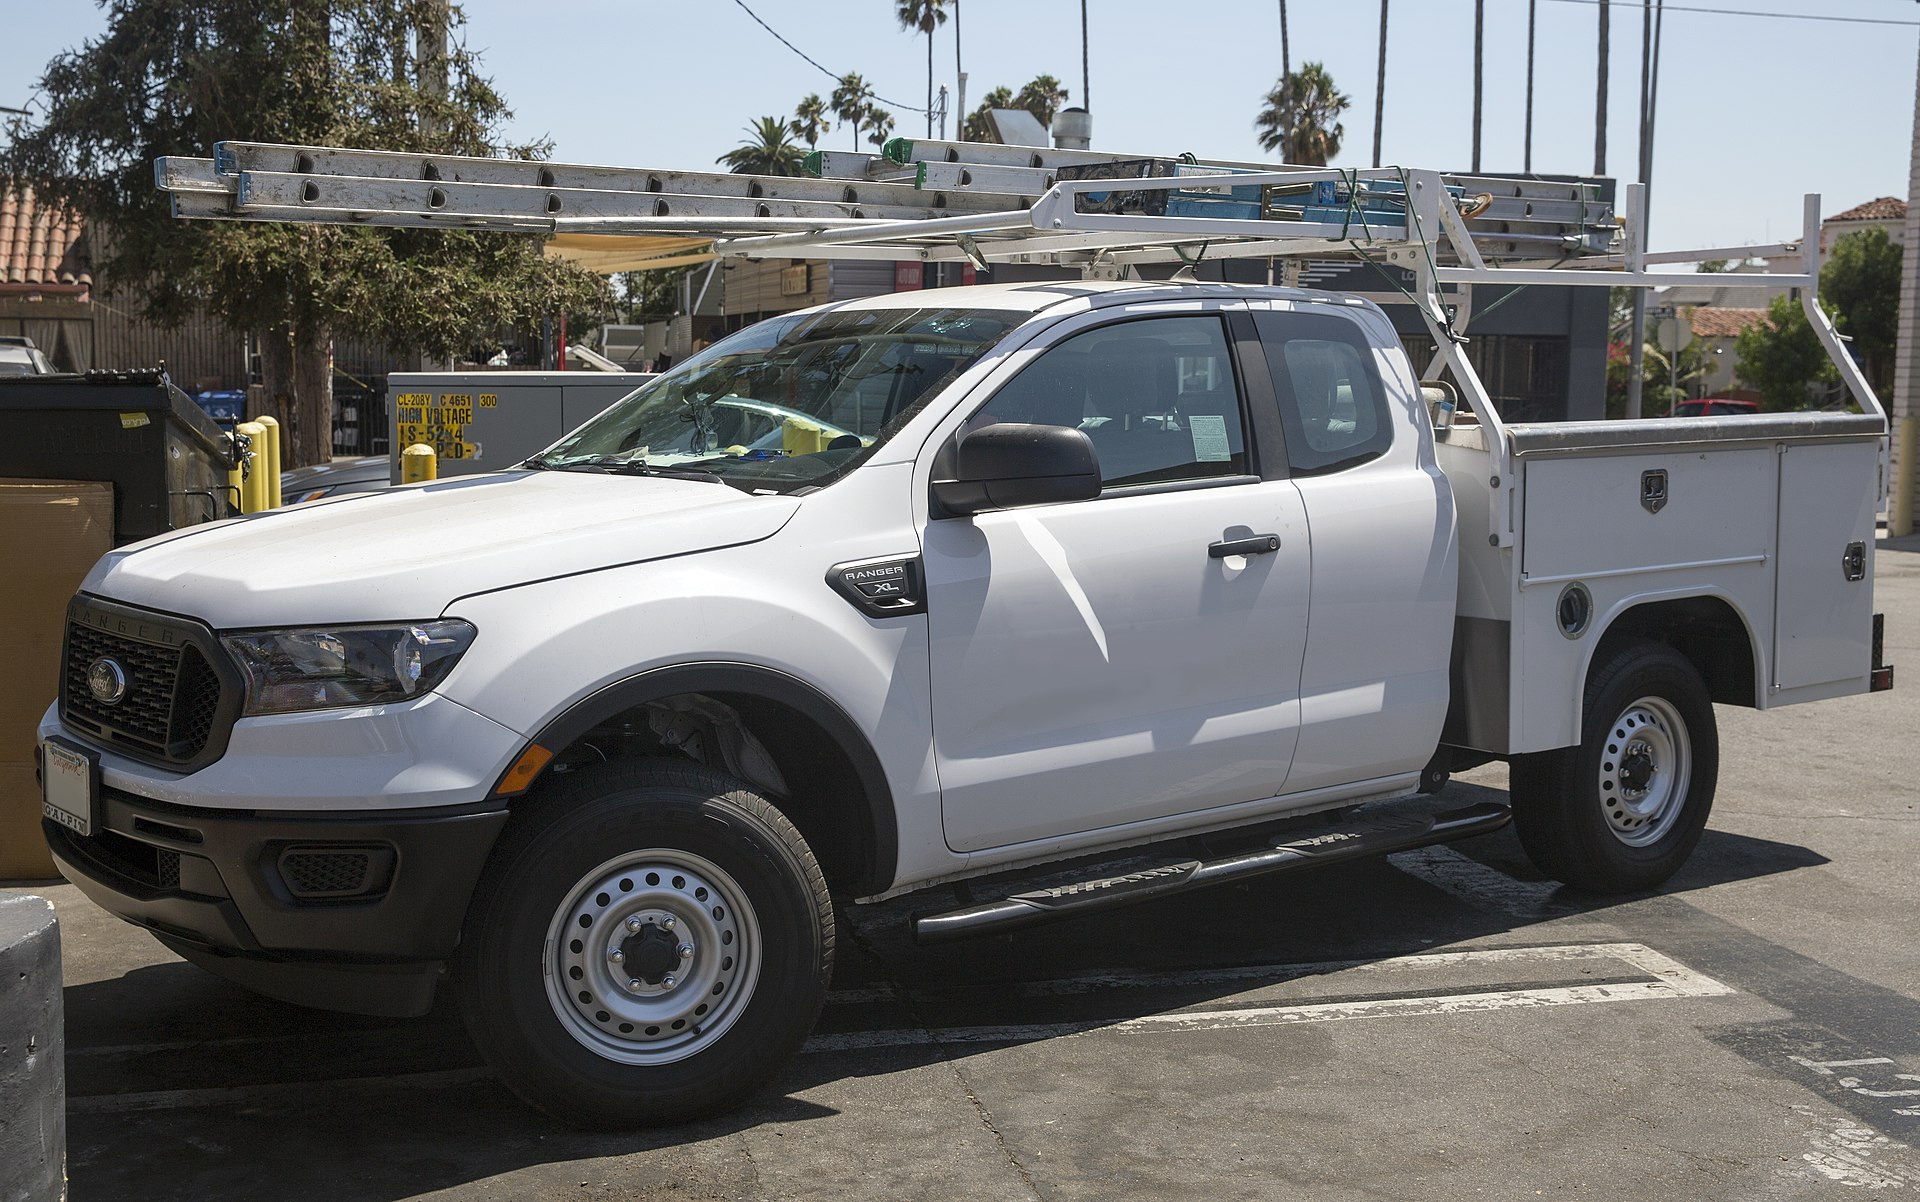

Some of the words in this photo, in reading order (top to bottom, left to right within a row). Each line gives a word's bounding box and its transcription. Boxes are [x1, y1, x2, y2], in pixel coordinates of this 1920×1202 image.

[398, 394, 430, 406] CL-208Y
[440, 395, 447, 406] C
[449, 395, 471, 406] 4651
[480, 395, 497, 407] 300
[398, 407, 423, 424] HIGH
[426, 408, 472, 425] VOLTAGE
[845, 566, 903, 580] RANGER
[874, 582, 899, 594] XL
